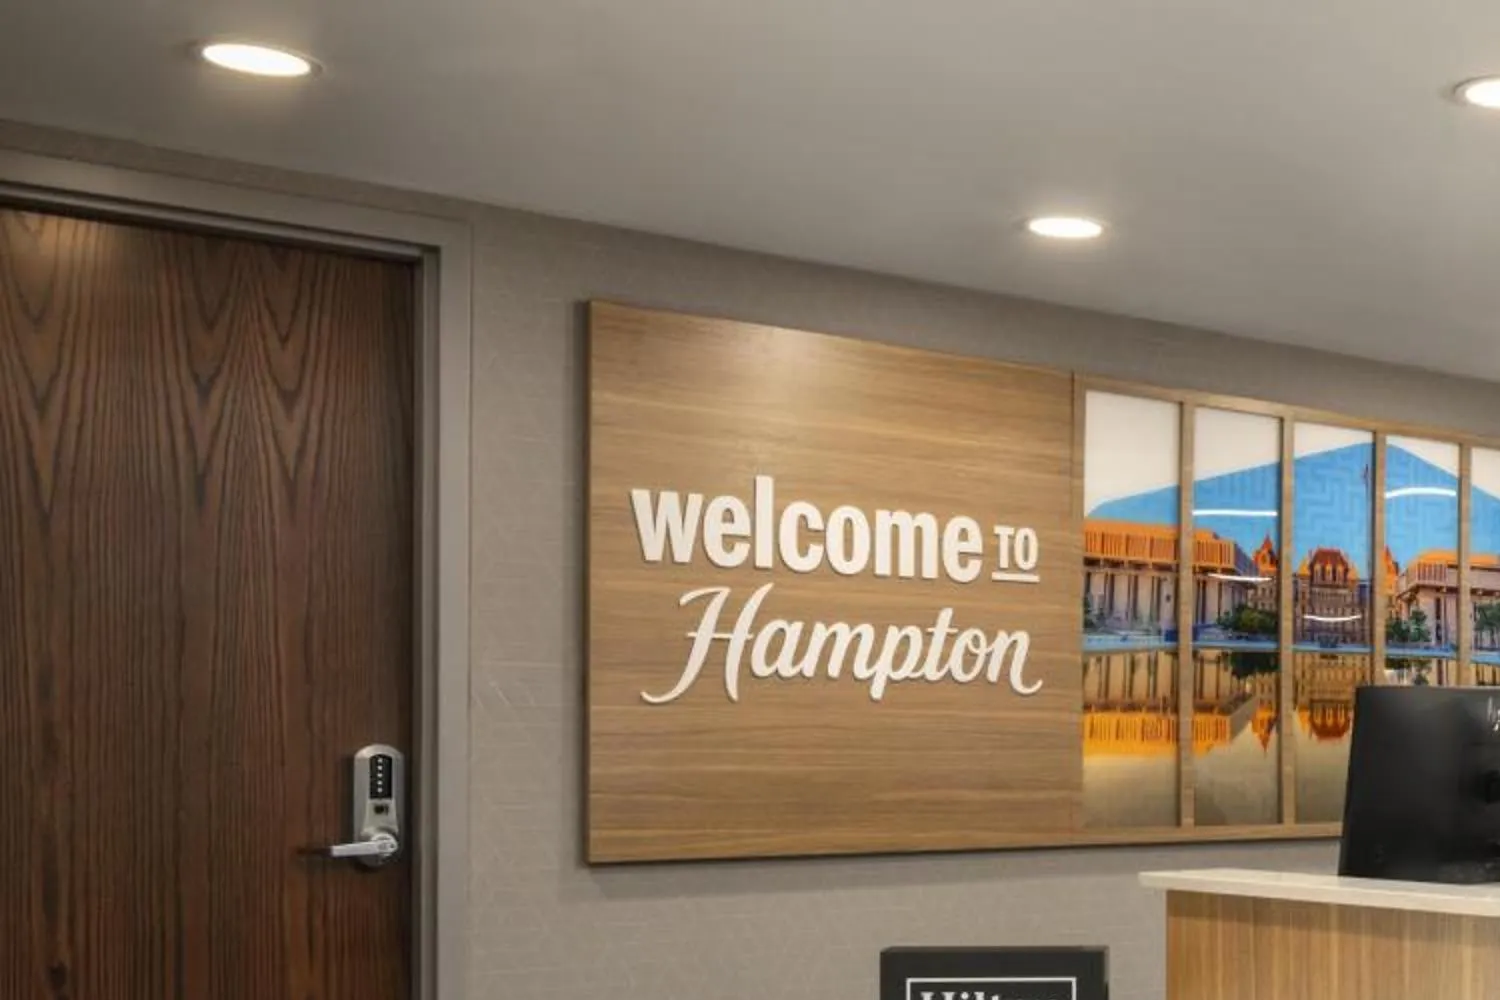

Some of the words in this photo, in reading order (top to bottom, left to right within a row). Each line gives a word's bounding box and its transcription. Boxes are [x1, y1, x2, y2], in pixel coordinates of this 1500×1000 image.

[631, 475, 983, 584] welcome
[993, 525, 1039, 573] TO
[640, 582, 1043, 704] Hampton
